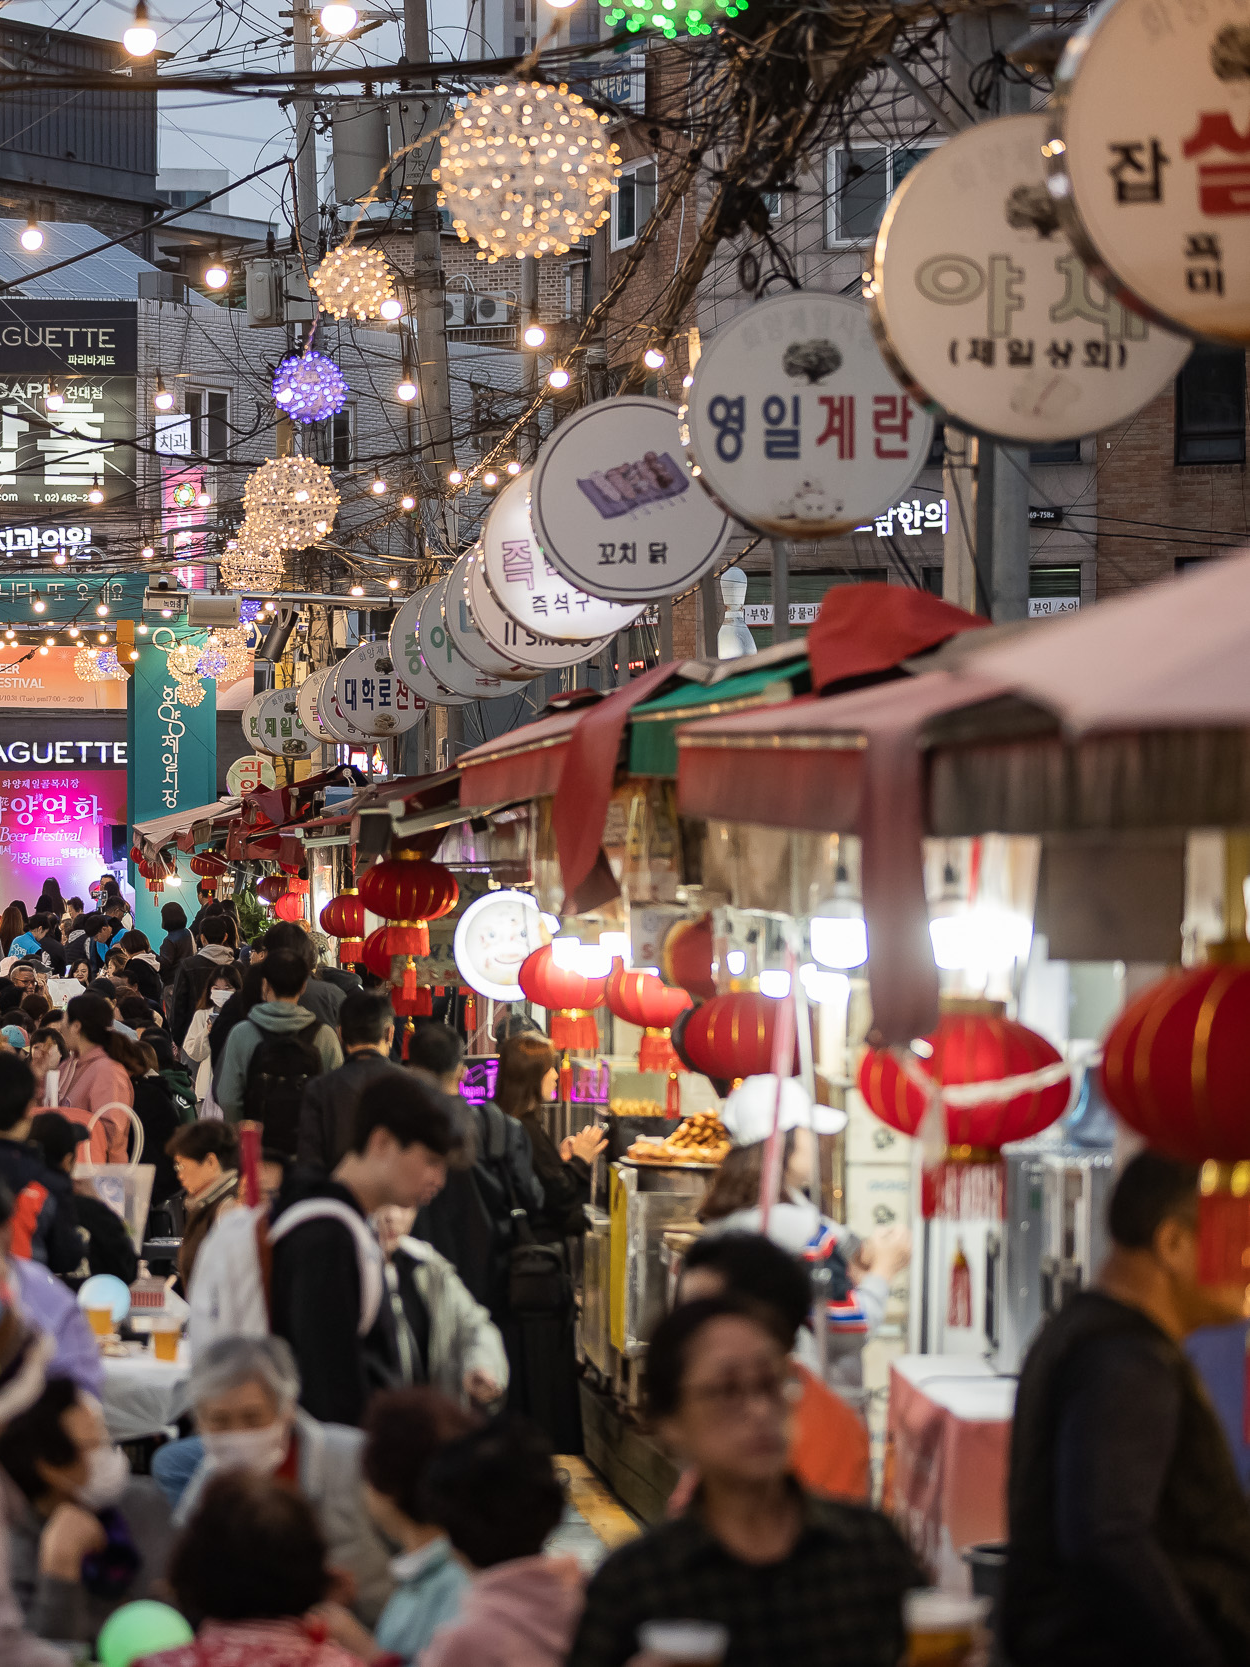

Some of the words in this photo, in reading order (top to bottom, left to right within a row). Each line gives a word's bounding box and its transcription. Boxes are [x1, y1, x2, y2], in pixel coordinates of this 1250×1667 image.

[68, 355, 115, 366] 파리바게뜨
[66, 385, 103, 400] 건대점
[160, 433, 188, 450] 치과
[597, 542, 637, 566] 꼬치
[648, 542, 669, 566] 닭
[46, 583, 65, 600] 또
[2, 778, 80, 789] 화양제일골목시장
[33, 826, 83, 842] Festival
[11, 852, 31, 864] 가장
[31, 857, 63, 866] 아름답고
